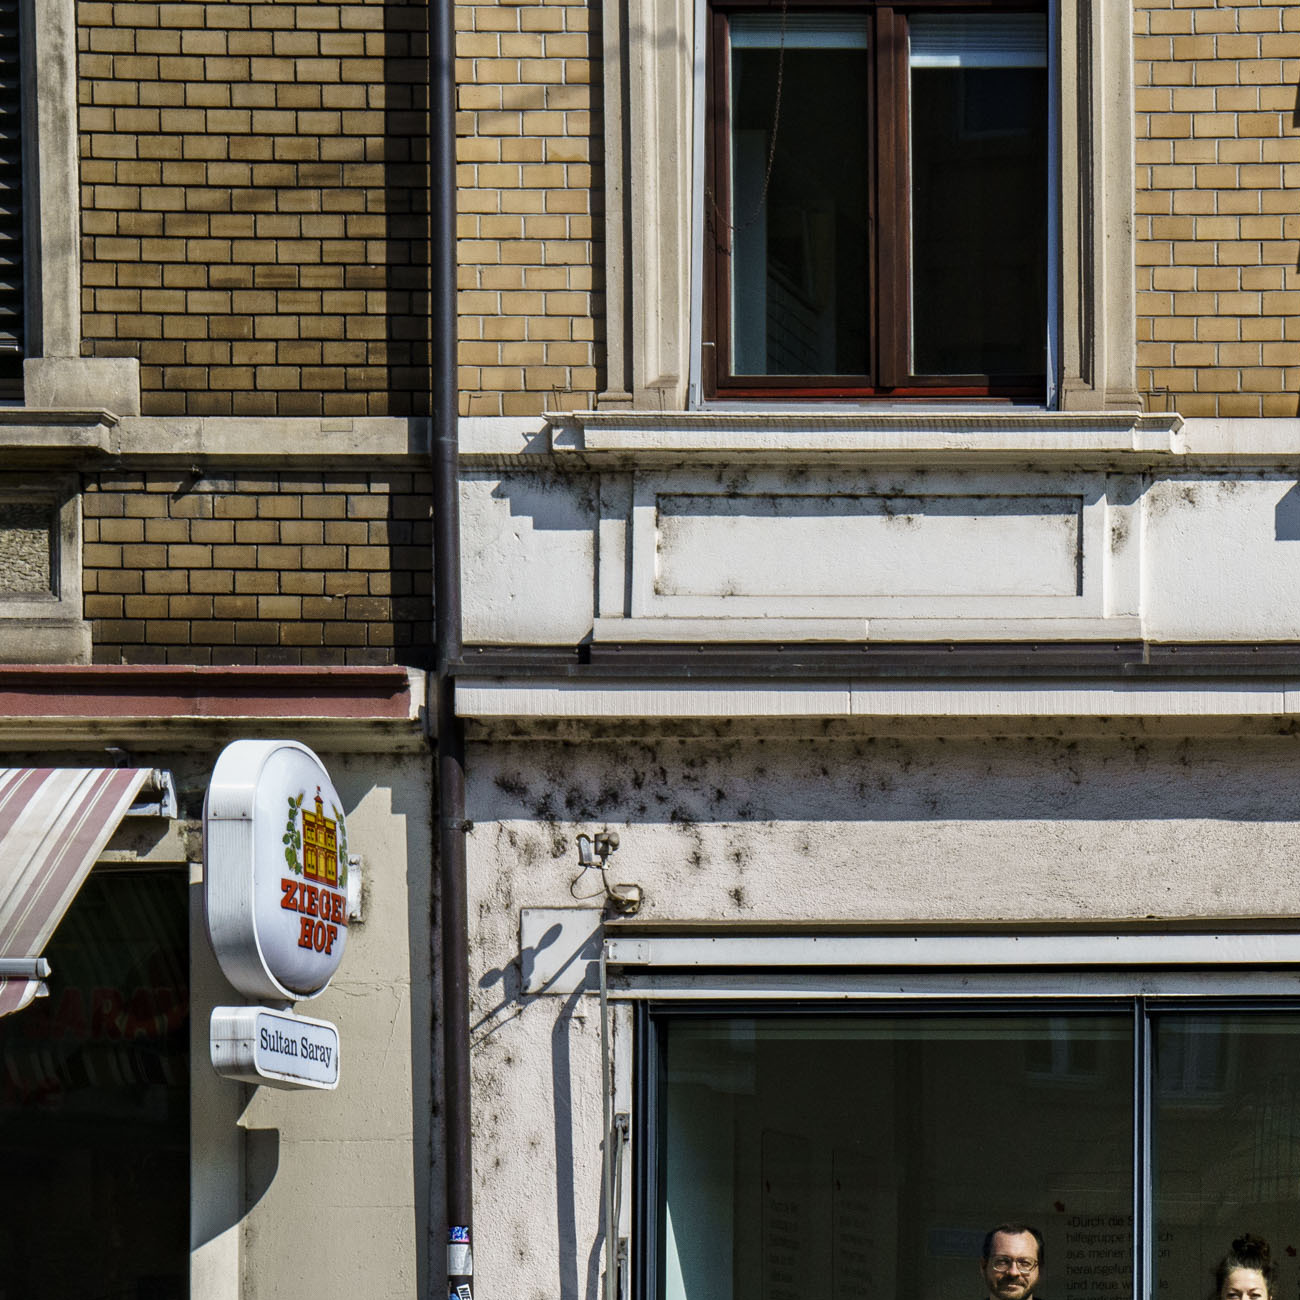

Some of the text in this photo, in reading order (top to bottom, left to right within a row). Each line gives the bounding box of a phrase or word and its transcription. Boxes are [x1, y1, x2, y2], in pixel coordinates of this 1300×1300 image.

[281, 878, 349, 926] ZIEGEL
[297, 916, 338, 955] HOF
[260, 1027, 332, 1068] Sultan Saray
